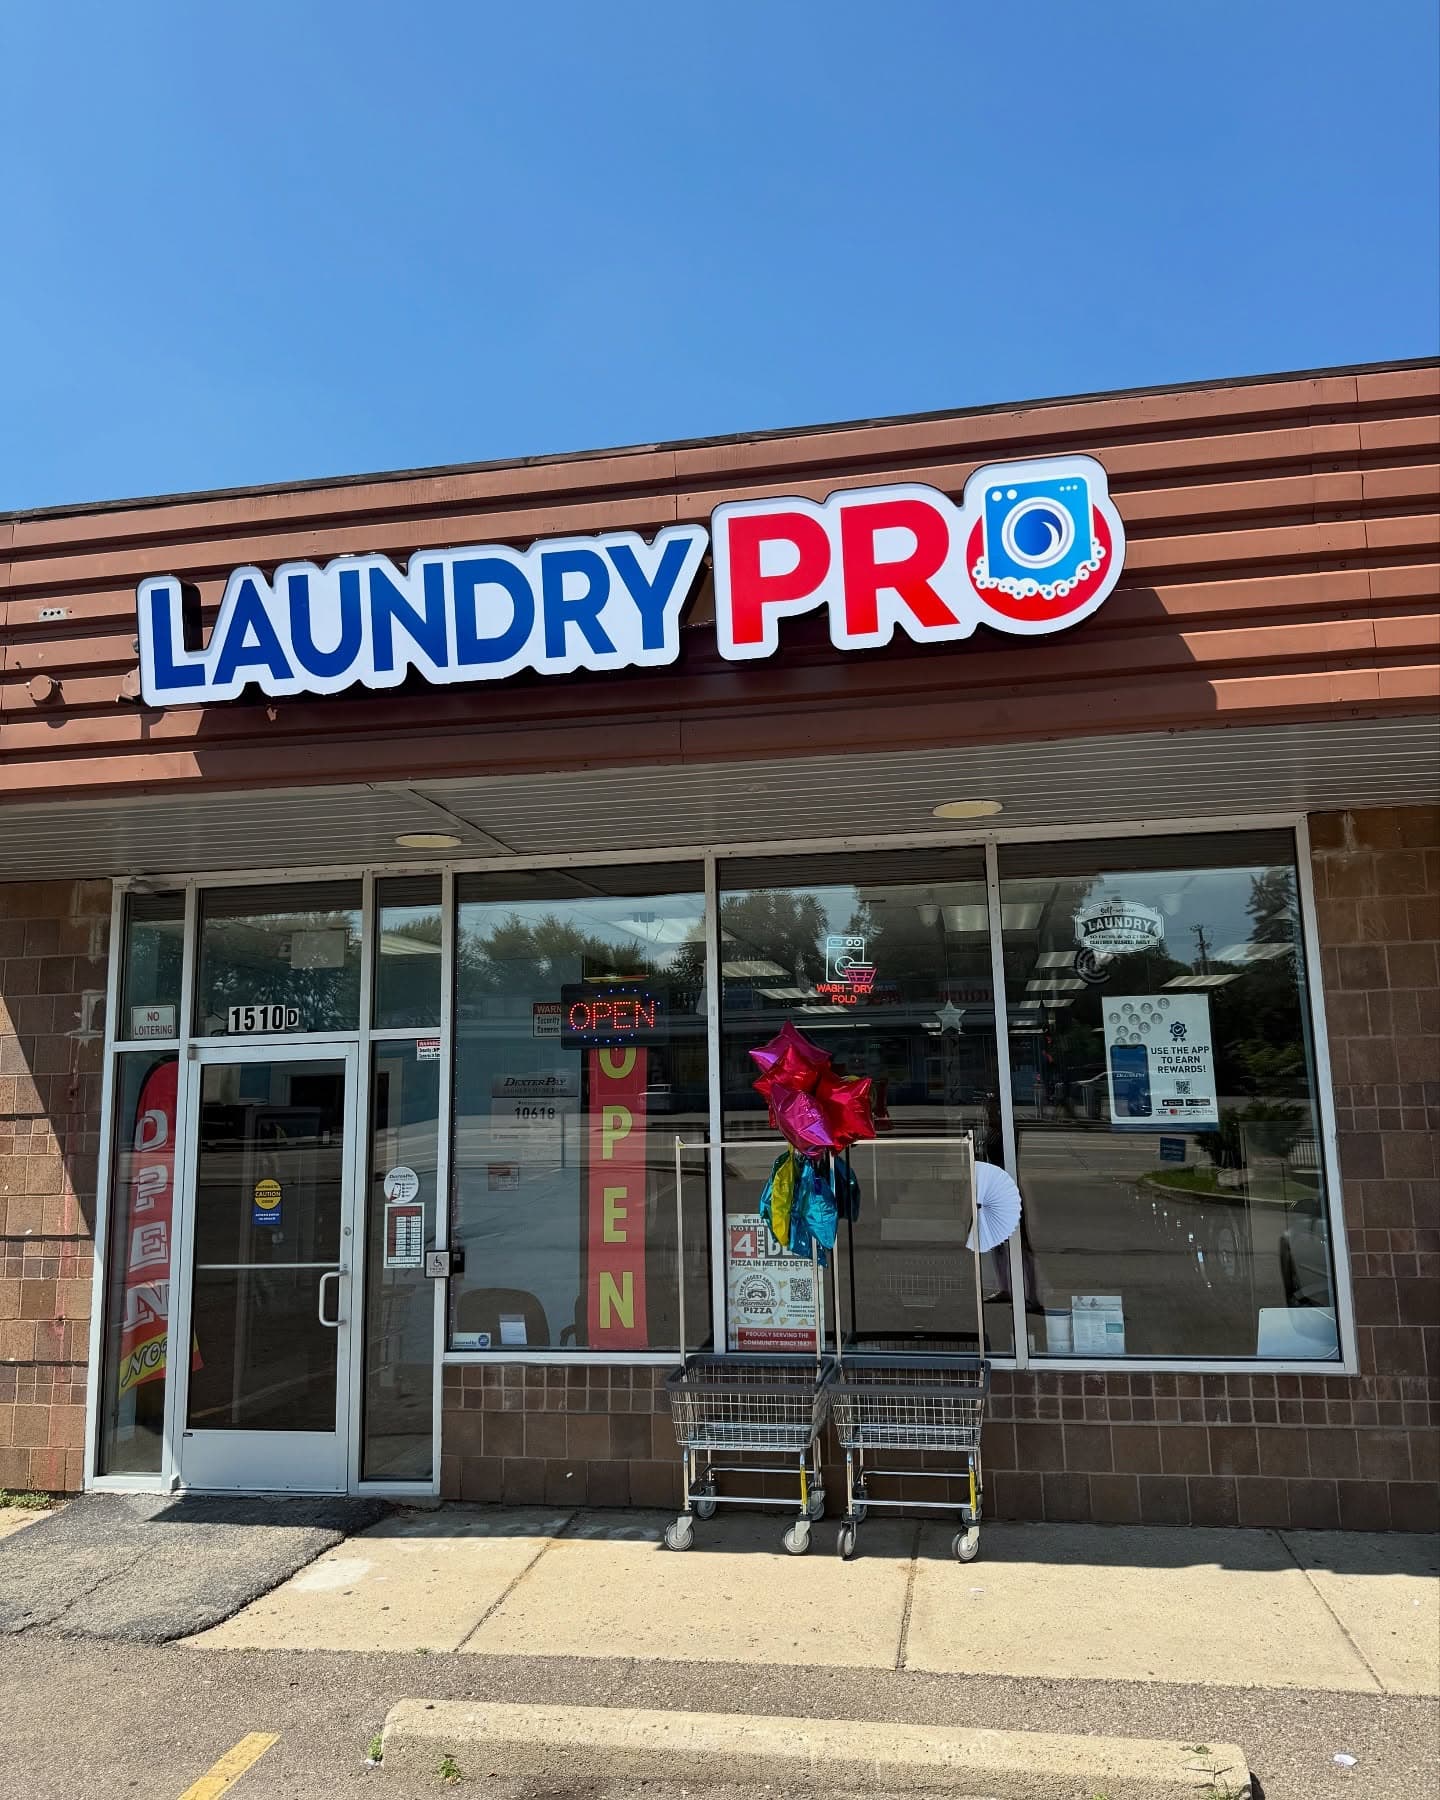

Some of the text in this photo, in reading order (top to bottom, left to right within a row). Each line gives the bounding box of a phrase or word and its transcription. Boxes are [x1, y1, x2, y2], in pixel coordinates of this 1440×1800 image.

[151, 539, 694, 690] LAUNDRY
[1087, 916, 1152, 931] LAUNDRY
[832, 995, 858, 1004] FOLD
[537, 1005, 561, 1014] WARN
[569, 1000, 655, 1030] OPEN
[147, 1011, 160, 1021] NO
[134, 1024, 173, 1036] LOITERING
[1151, 1046, 1210, 1055] USE THE APP
[1161, 1056, 1200, 1064] TO EARN
[1157, 1065, 1206, 1074] REWARDS!
[514, 1107, 556, 1120] 10618
[122, 1109, 170, 1333] OPEN
[733, 1233, 755, 1257] 4
[743, 1306, 773, 1315] PIZZA
[121, 1337, 168, 1387] NO
